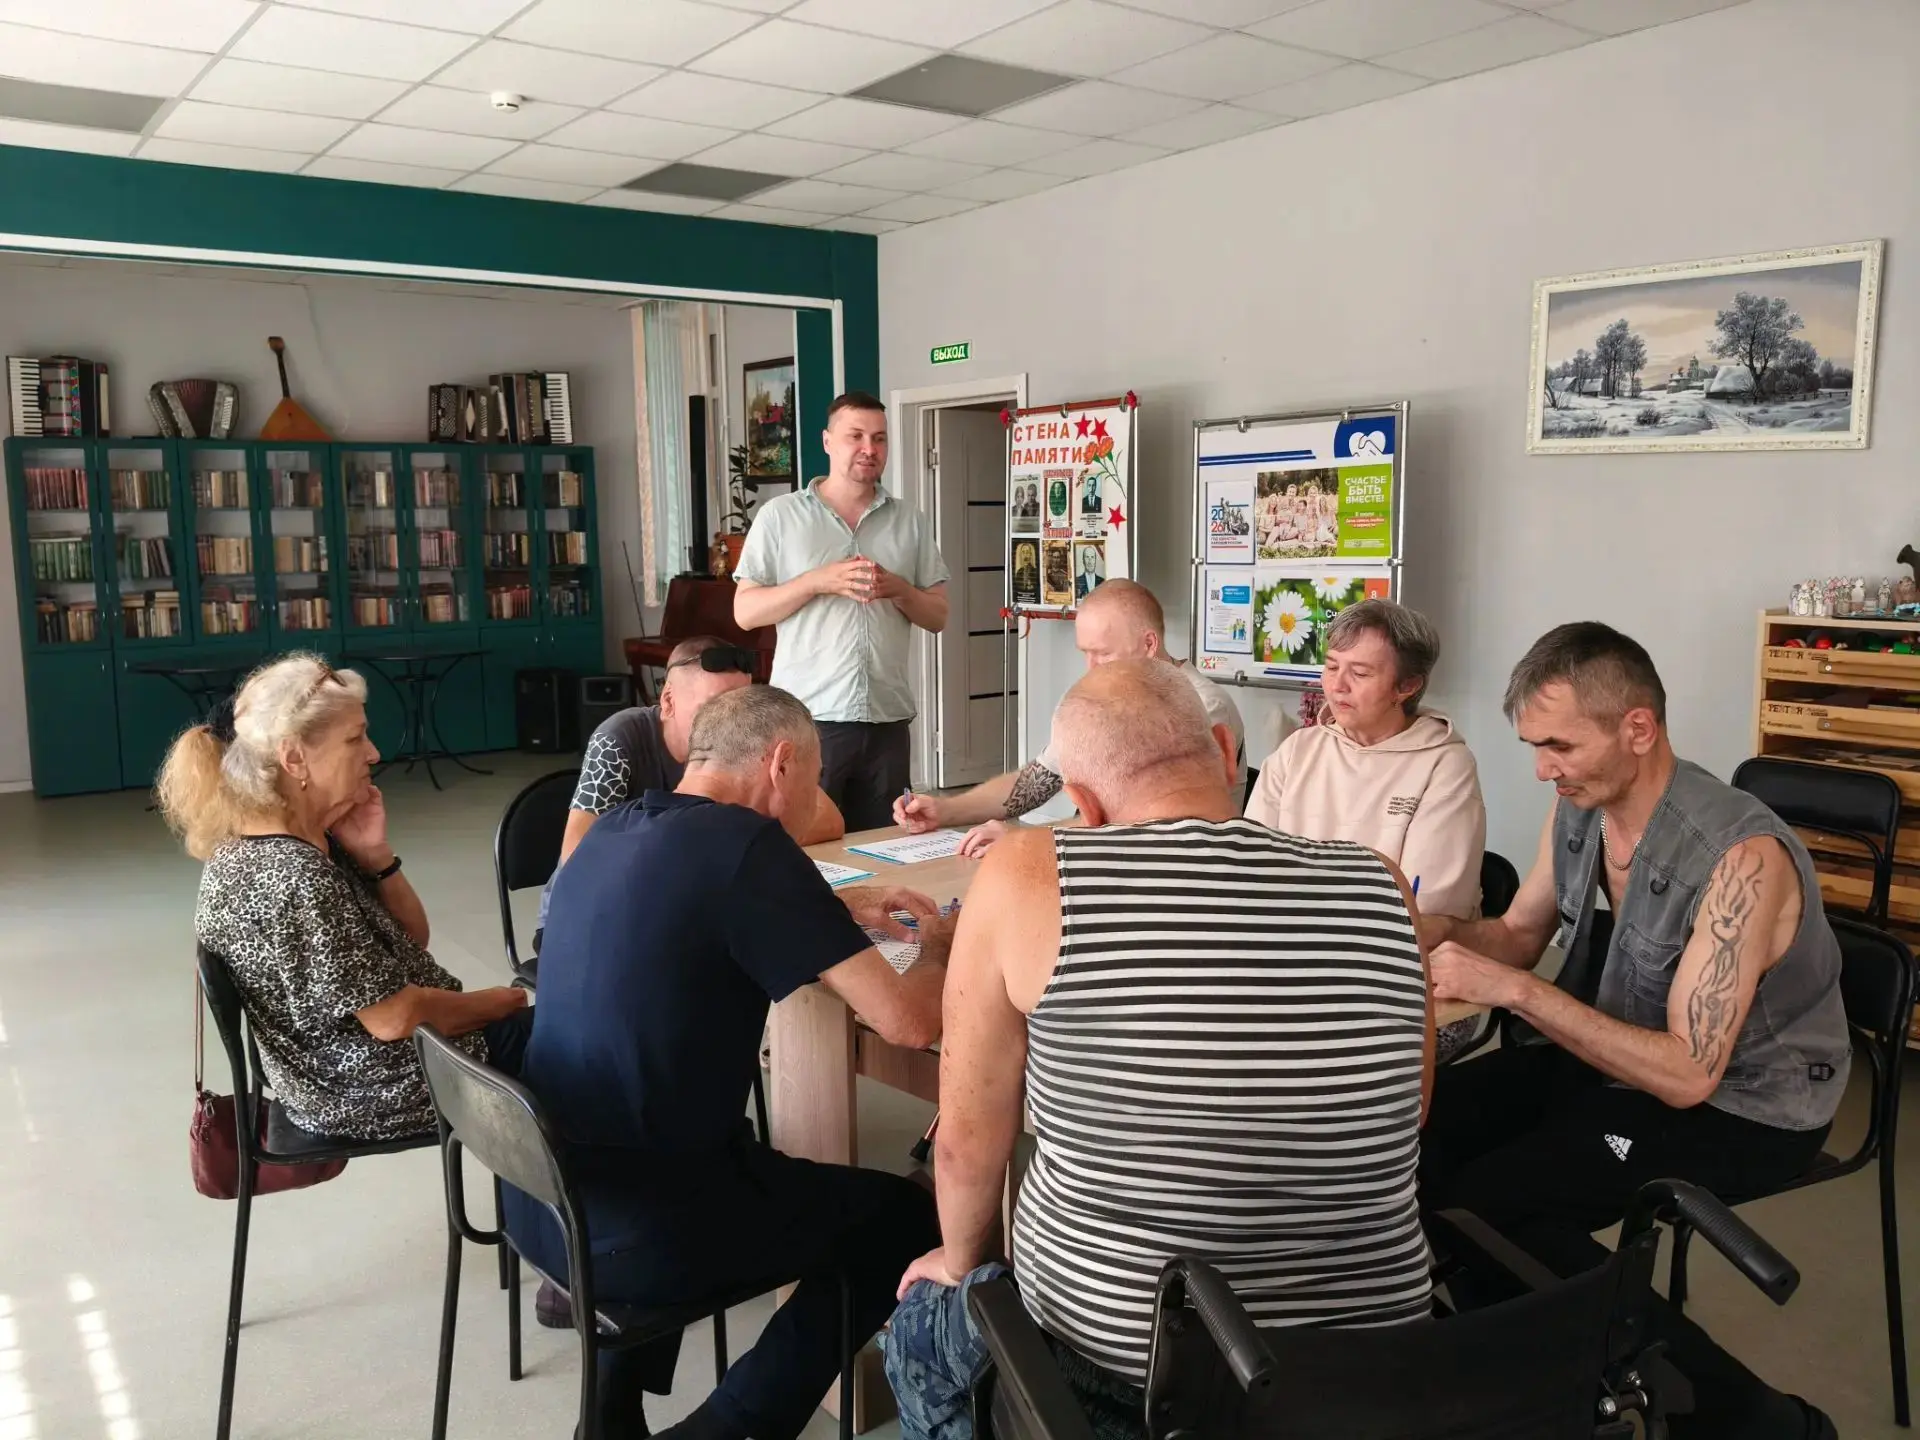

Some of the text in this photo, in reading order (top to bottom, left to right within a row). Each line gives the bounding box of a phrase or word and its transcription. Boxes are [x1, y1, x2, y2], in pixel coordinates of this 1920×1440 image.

[933, 345, 965, 361] ВЫХОД
[1014, 422, 1070, 443] СТЕНА
[1012, 446, 1082, 465] ПАМЯТИ
[1344, 476, 1387, 486] СЧАСТЬЕ
[1348, 484, 1382, 496] БЫТЬ
[1345, 494, 1384, 504] ВМЕСТЕ!
[1211, 508, 1224, 521] 20
[1211, 520, 1225, 533] 26
[1370, 590, 1378, 599] 8
[1325, 609, 1340, 618] Сч
[1604, 1133, 1627, 1162] adidas
